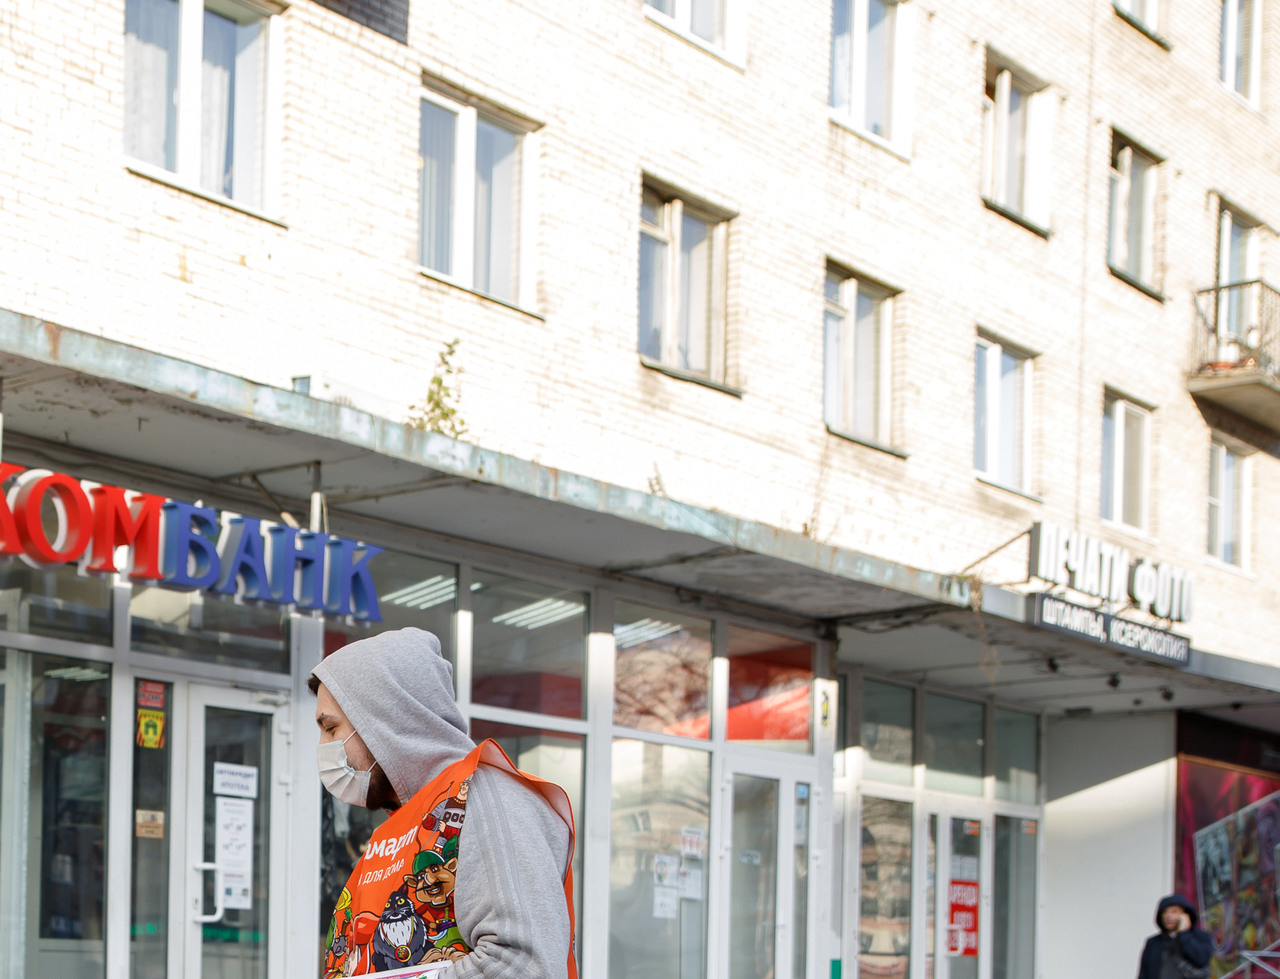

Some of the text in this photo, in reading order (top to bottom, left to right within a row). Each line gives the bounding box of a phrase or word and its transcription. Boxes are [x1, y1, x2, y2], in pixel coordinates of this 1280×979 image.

[1035, 520, 1194, 624] ПЕЧАТИ ФОТО
[1042, 597, 1189, 662] ШТАМПЫ, КСЕРОКОПИЯ
